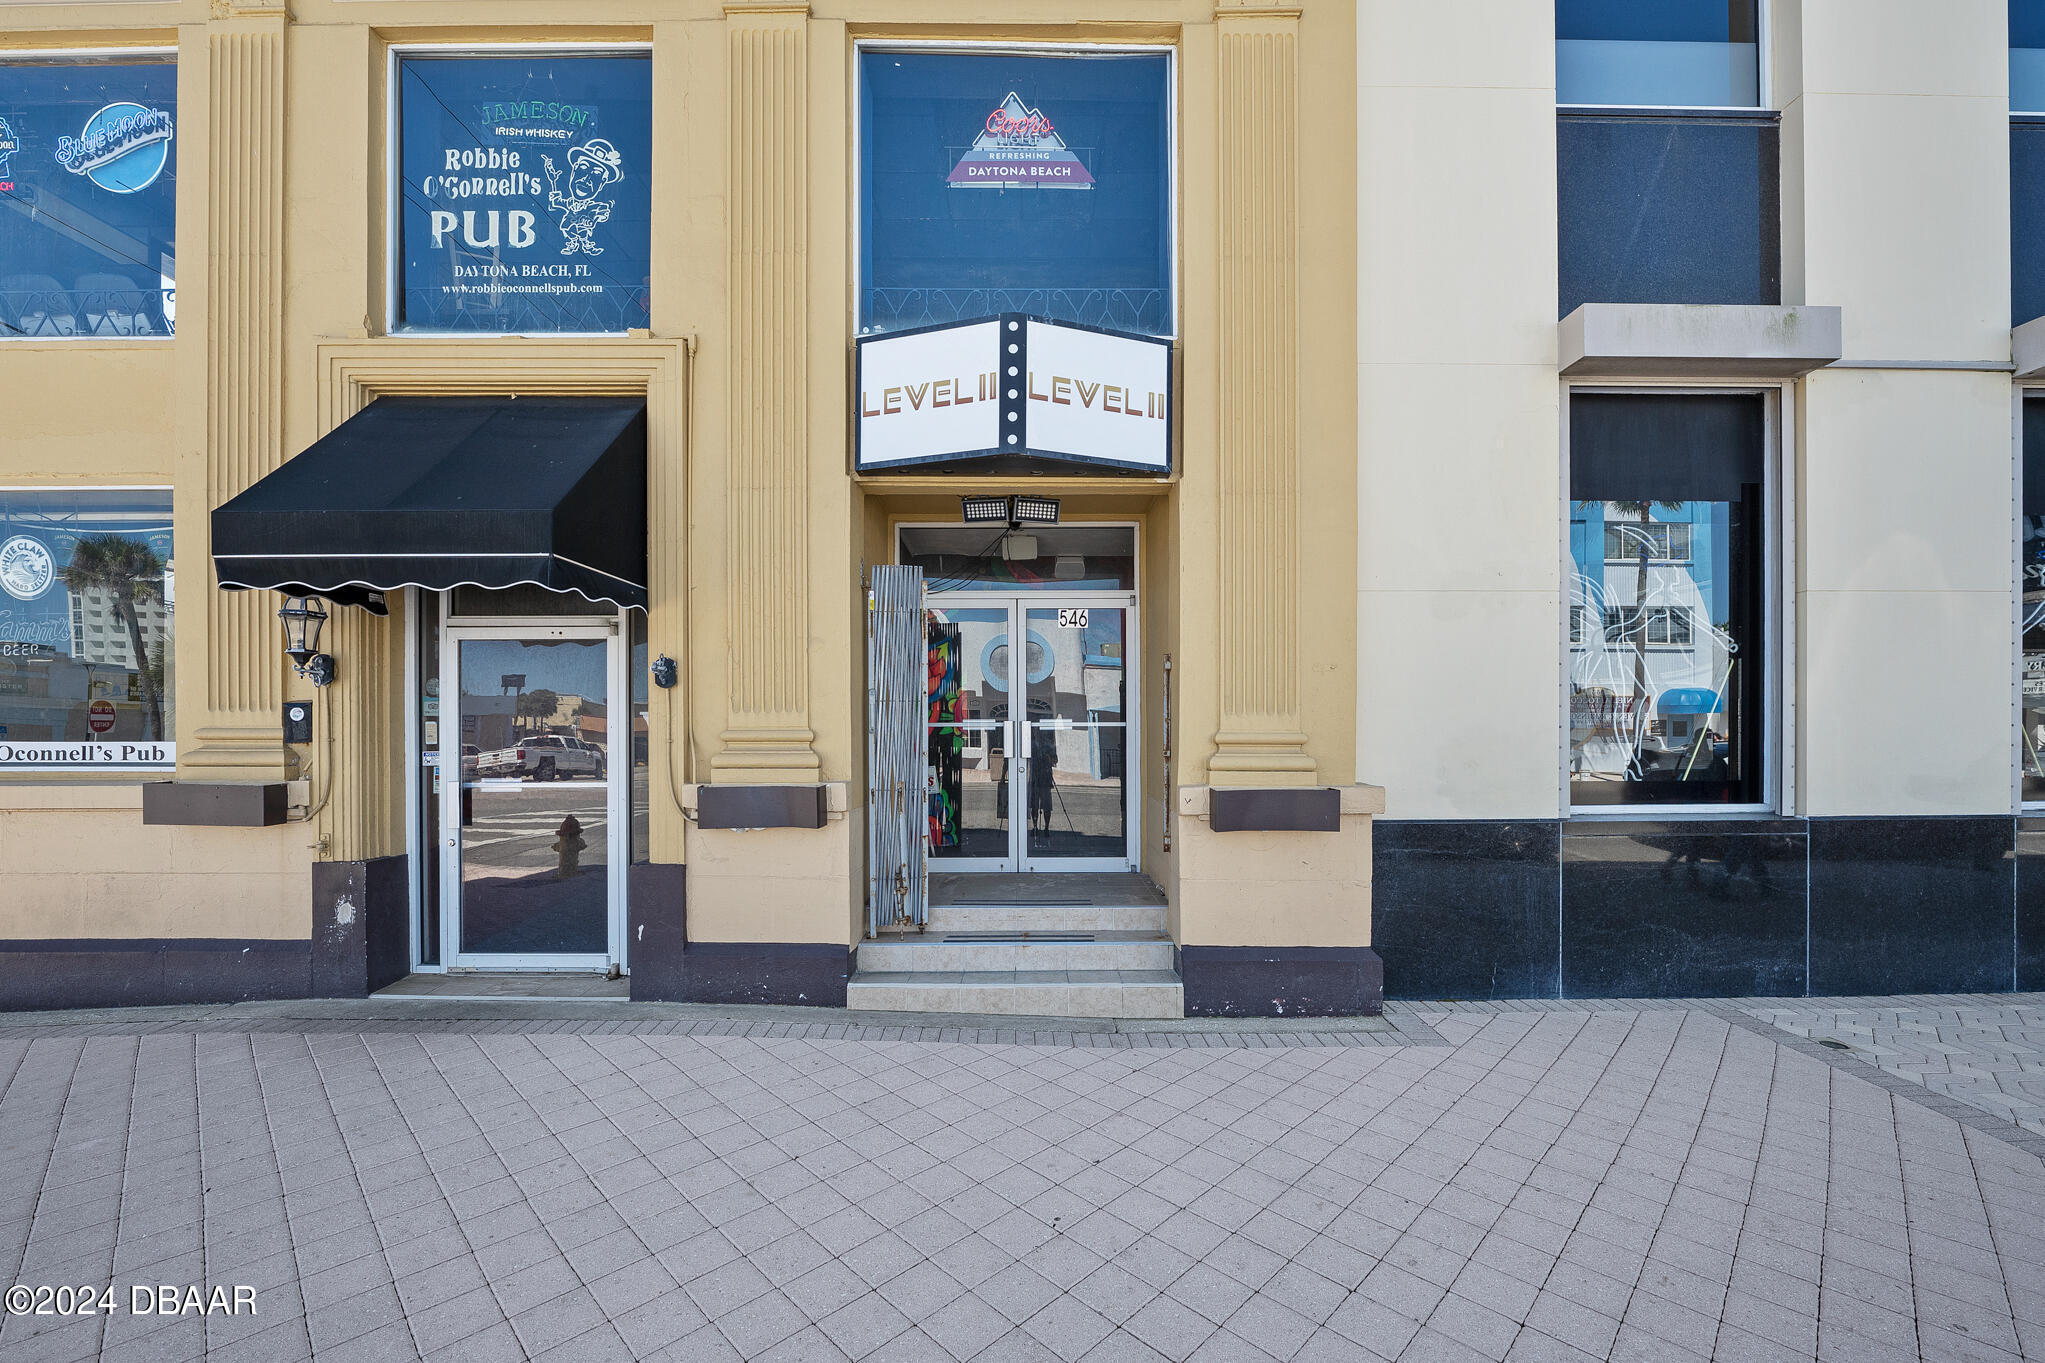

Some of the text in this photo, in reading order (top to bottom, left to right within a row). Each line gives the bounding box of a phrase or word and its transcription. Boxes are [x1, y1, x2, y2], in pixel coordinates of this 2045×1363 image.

[481, 101, 589, 127] JAMESON
[986, 108, 1051, 133] Coors
[55, 108, 158, 164] BLUE MOON
[495, 126, 574, 139] IRISH WHISKEY
[445, 147, 520, 171] Robbie
[989, 152, 1050, 160] REFRESHING
[968, 166, 1071, 177] DAYTONA BEACH
[423, 172, 542, 199] O'Connell's
[430, 210, 536, 249] PUB
[455, 265, 592, 278] DAYTONA BEACH, FL
[442, 283, 603, 296] www.robbieoconnellspub.com
[862, 378, 974, 418] LEVEL
[1028, 371, 1143, 417] LEVEL
[1, 542, 46, 576] WHITE CLAW
[11, 564, 47, 591] HARD SELTZER
[0, 610, 71, 643] amm's
[1059, 609, 1088, 628] 546
[3, 643, 39, 657] BEER
[0, 744, 165, 762] Oconnell's Pub
